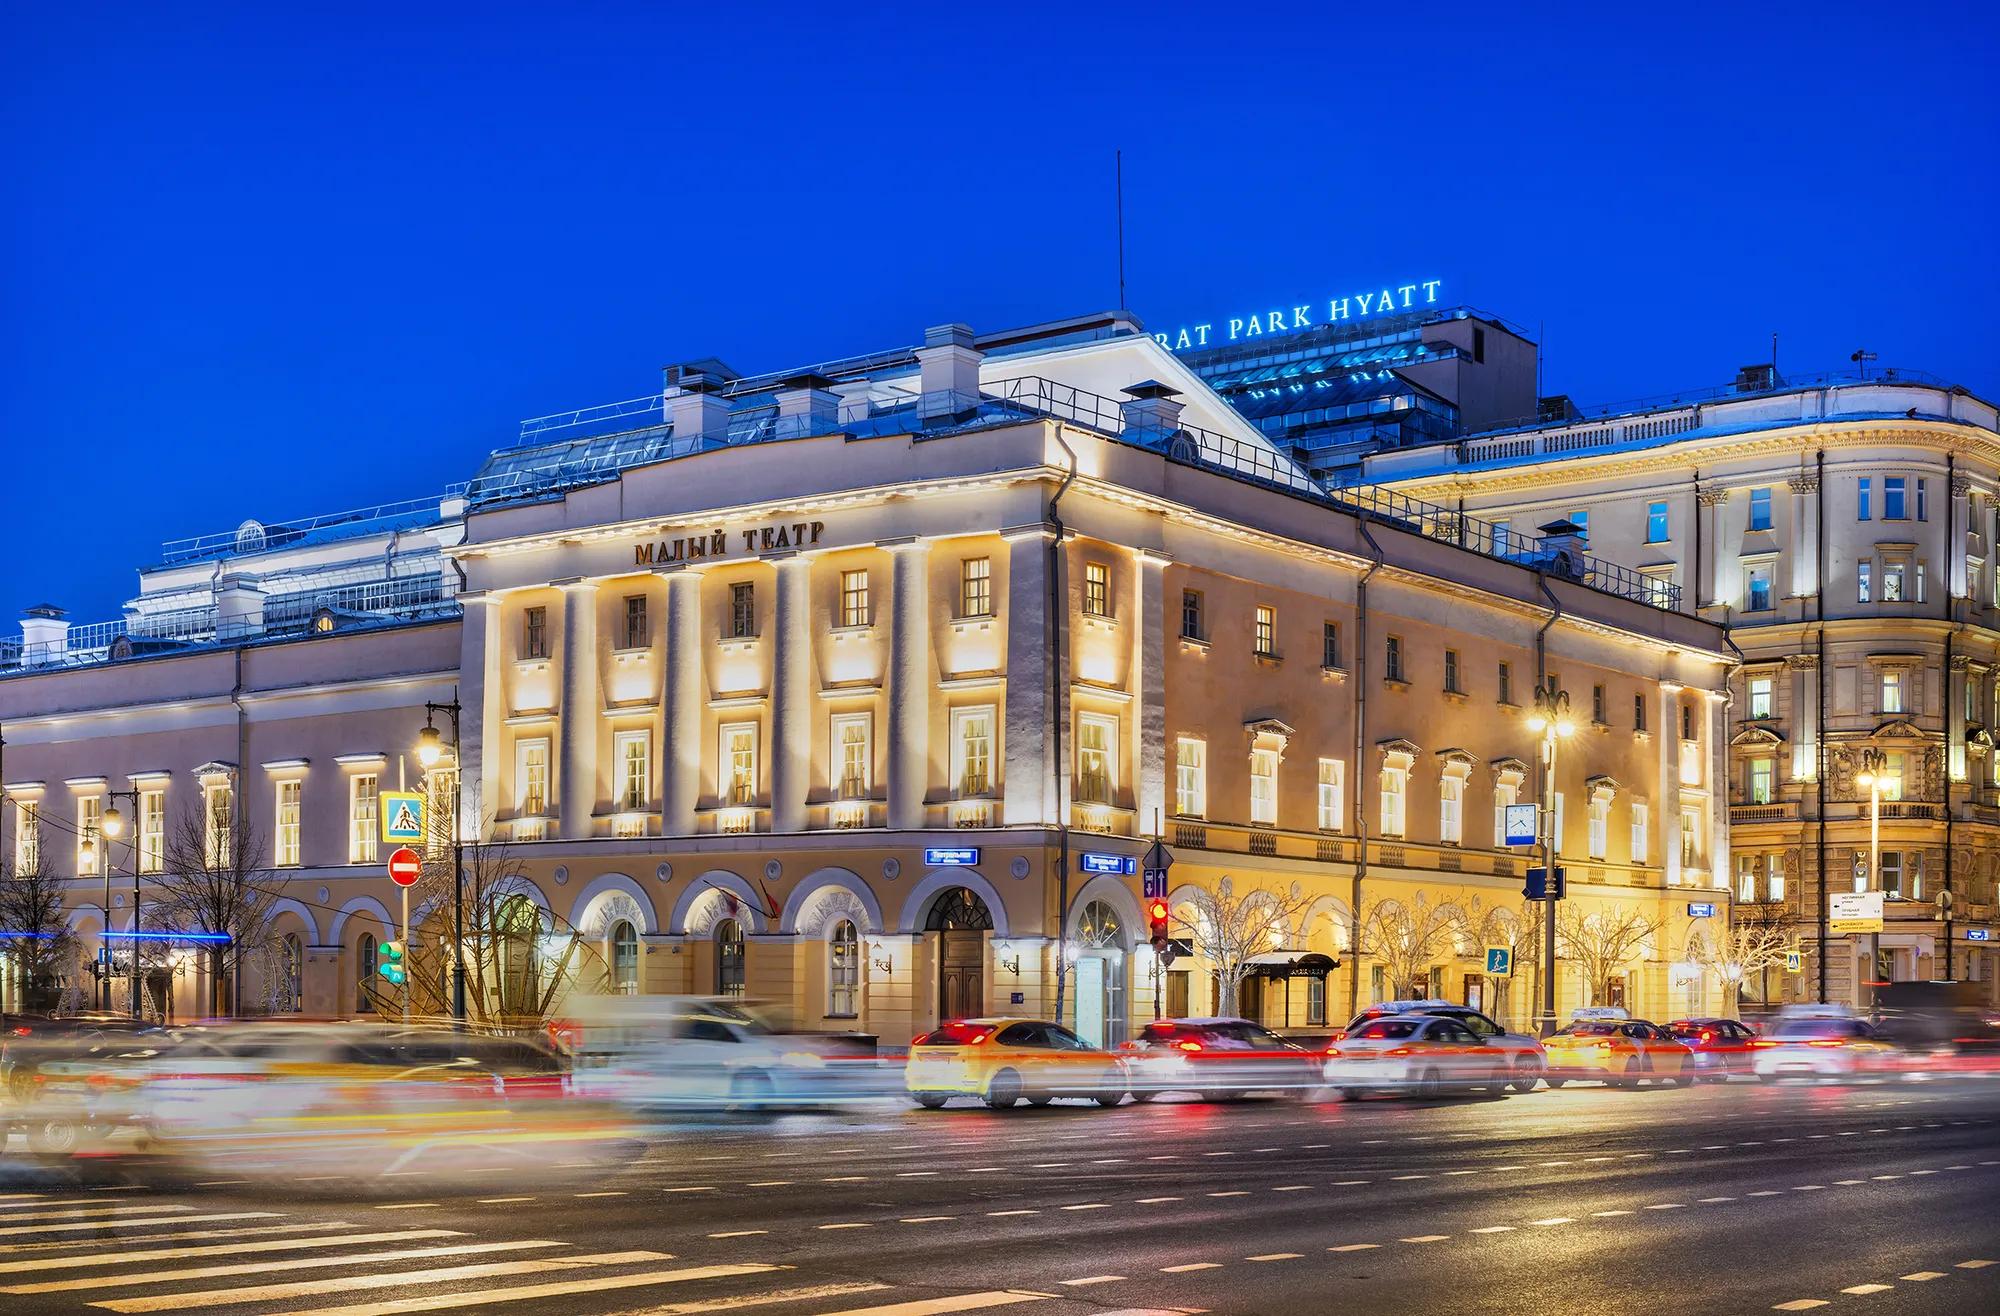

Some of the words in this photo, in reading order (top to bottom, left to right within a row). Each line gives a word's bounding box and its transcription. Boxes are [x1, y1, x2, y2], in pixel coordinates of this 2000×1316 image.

[1229, 305, 1312, 340] PARK
[1329, 280, 1442, 321] HYATT
[634, 529, 728, 566] МАЛЫЙ
[742, 521, 825, 552] ТЕАТР
